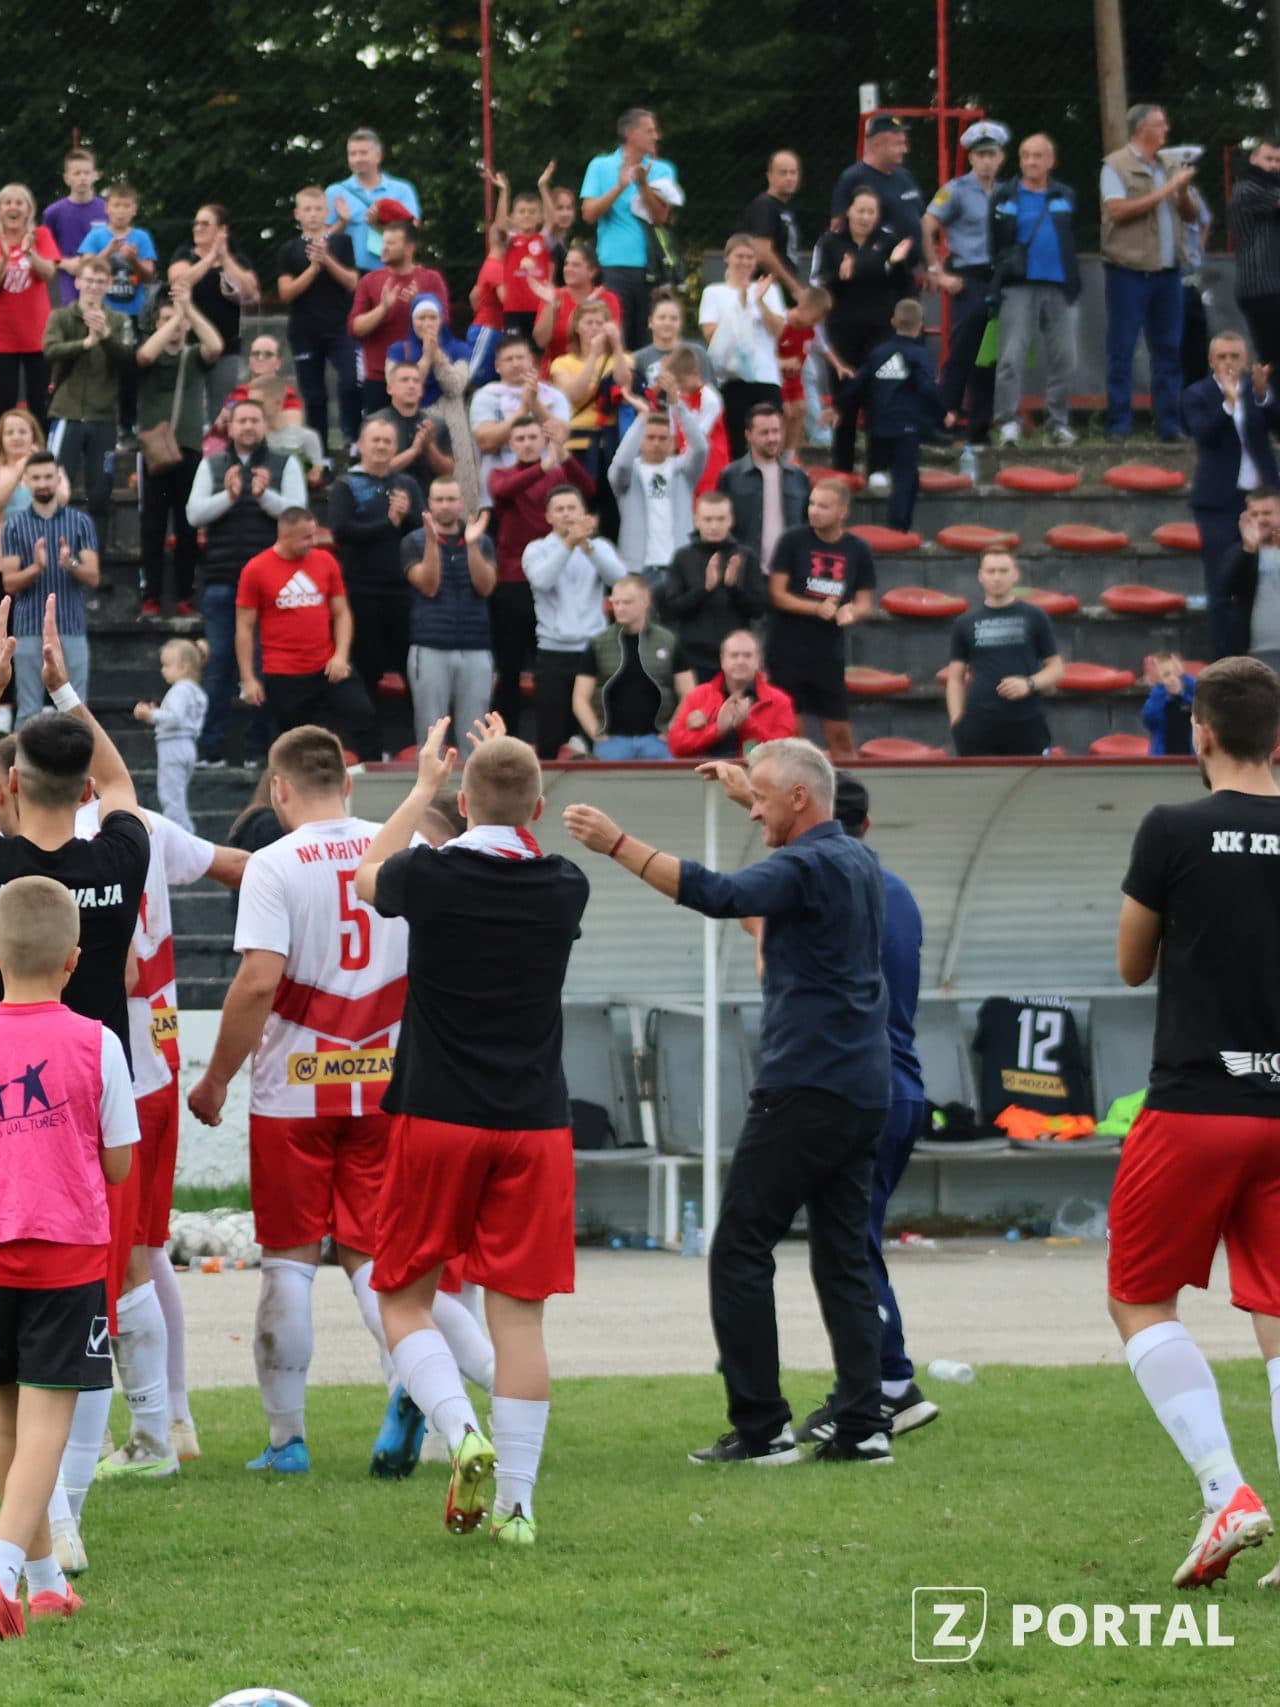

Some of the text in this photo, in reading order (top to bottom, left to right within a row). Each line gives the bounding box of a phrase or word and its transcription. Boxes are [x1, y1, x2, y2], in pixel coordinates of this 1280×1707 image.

[296, 843, 322, 865] NK
[1211, 831, 1280, 855] NK KR
[68, 883, 124, 909] VAJA
[336, 869, 371, 971] 5
[1017, 1008, 1064, 1073] 12
[7, 1111, 68, 1136] CULTURES
